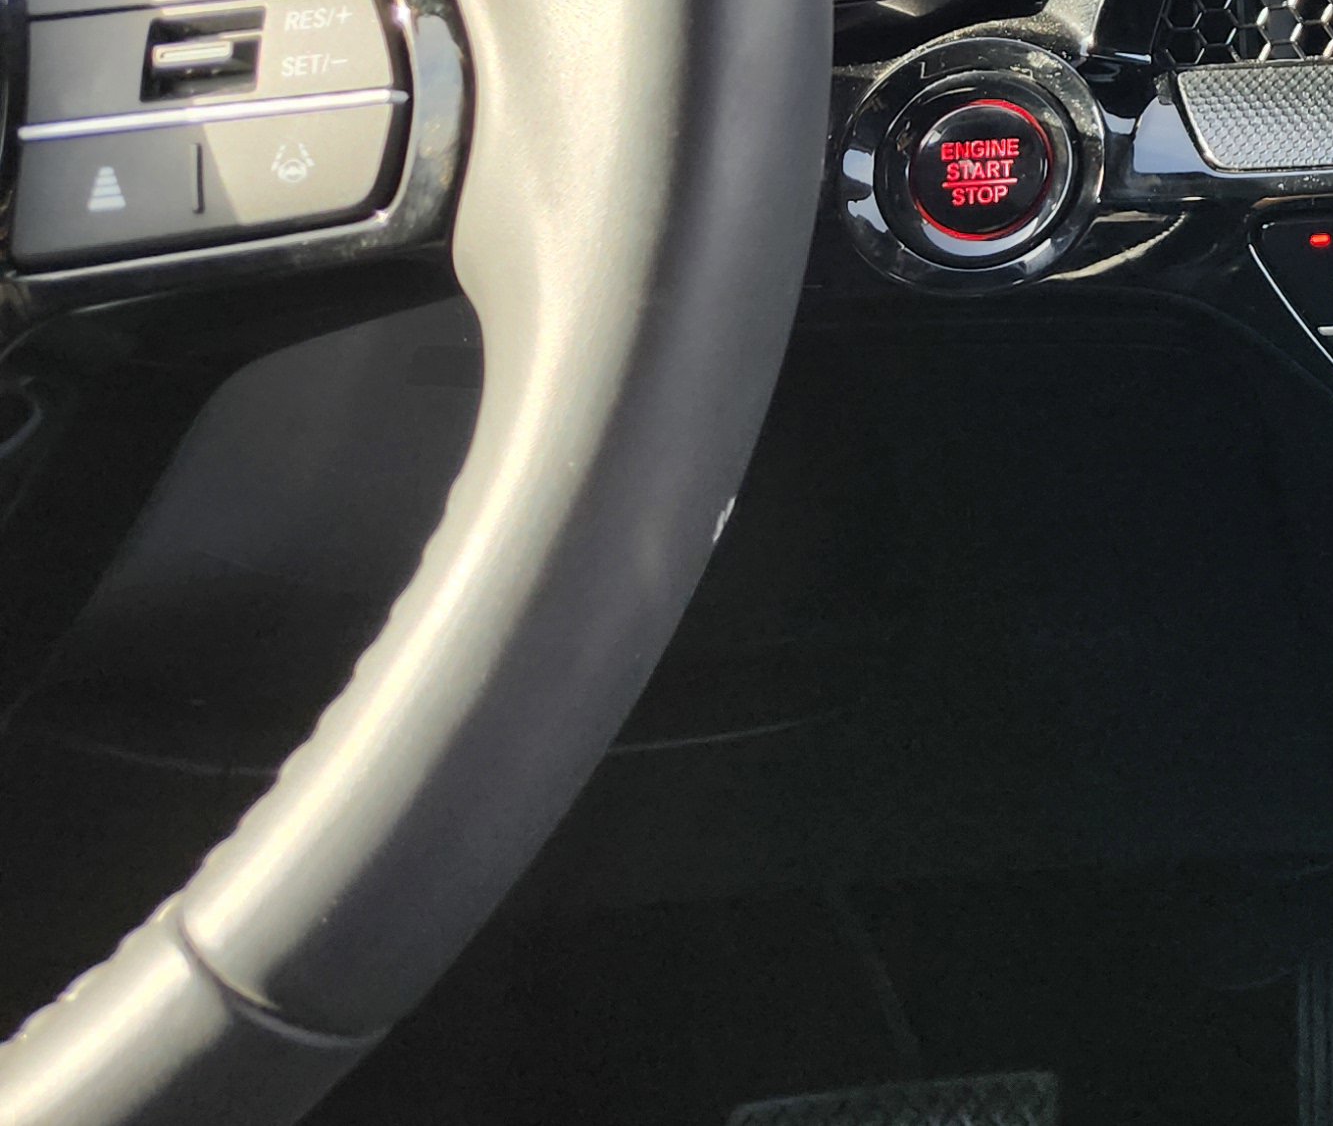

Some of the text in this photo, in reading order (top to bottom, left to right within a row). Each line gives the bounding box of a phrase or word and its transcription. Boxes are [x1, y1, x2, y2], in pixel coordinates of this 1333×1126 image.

[941, 138, 1020, 161] ENGINE
[946, 159, 1014, 182] START
[951, 185, 1009, 206] STOP
